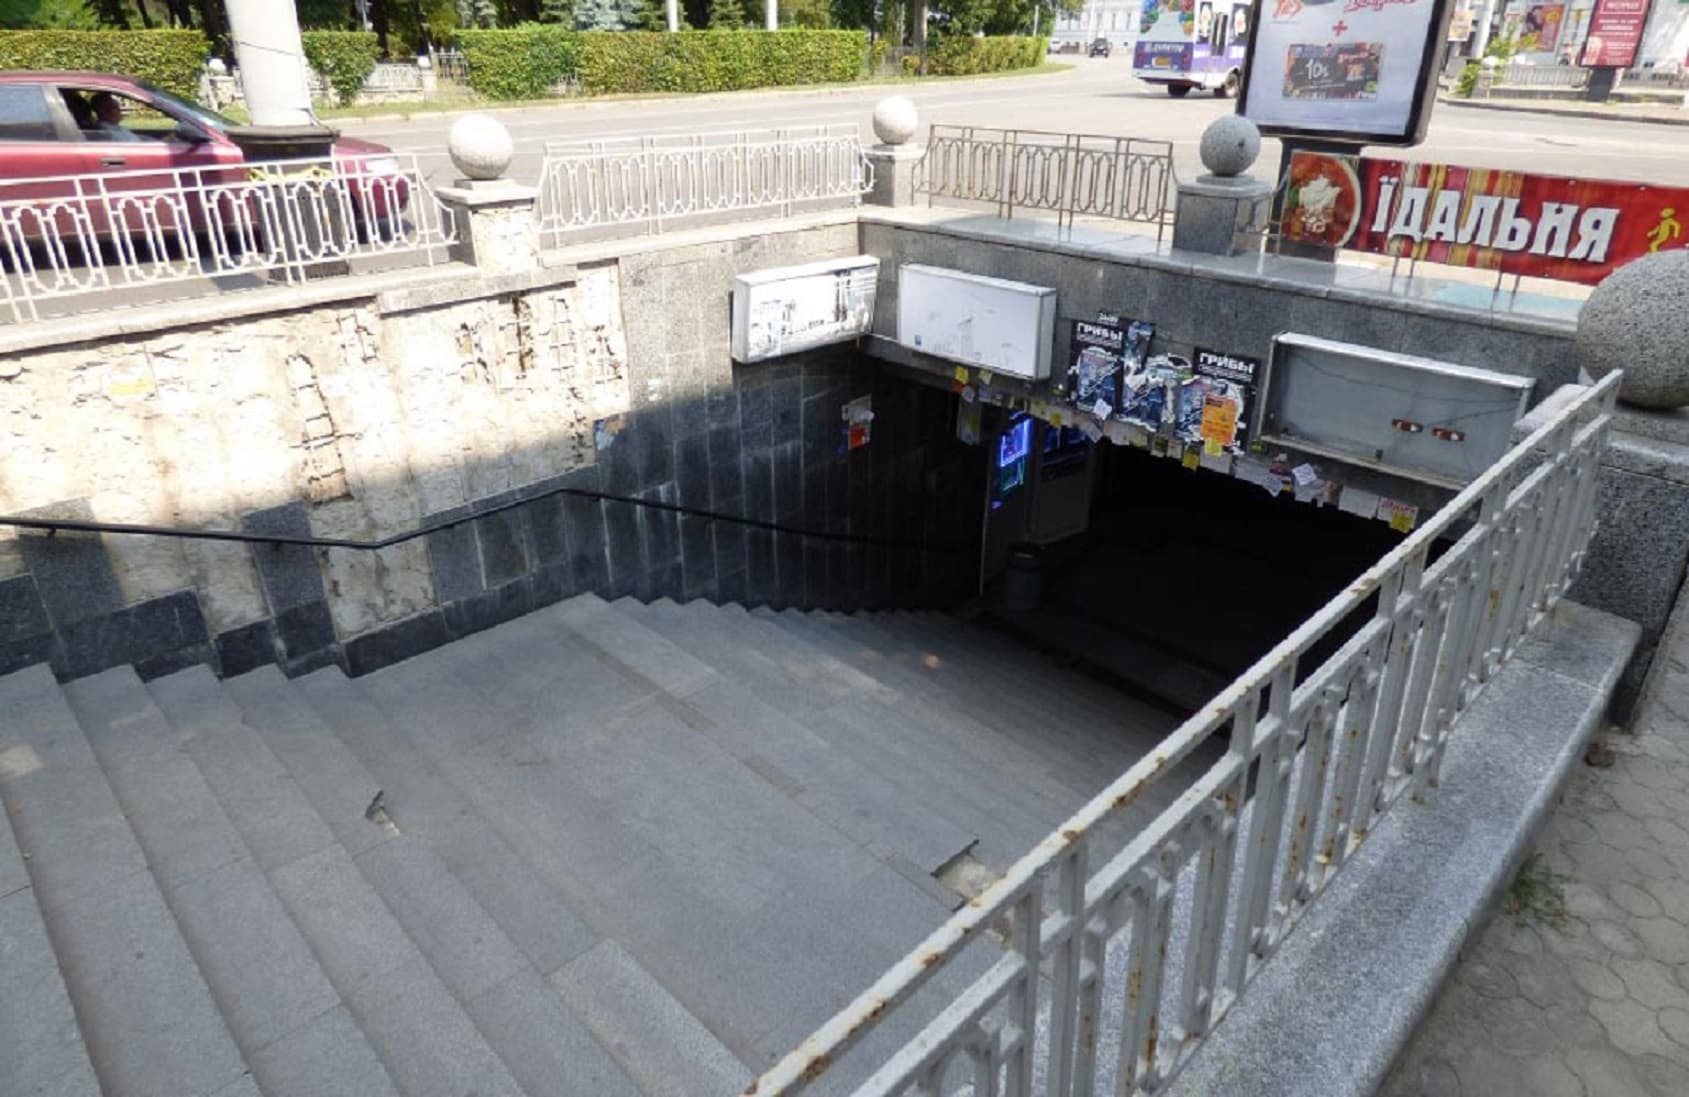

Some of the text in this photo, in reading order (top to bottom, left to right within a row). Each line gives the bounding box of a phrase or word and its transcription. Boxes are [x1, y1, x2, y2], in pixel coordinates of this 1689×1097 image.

[1371, 176, 1620, 263] ЇДАЛЬНЯ
[1077, 322, 1124, 341] ГРИБЫ
[1200, 353, 1255, 374] ГРИБЫ
